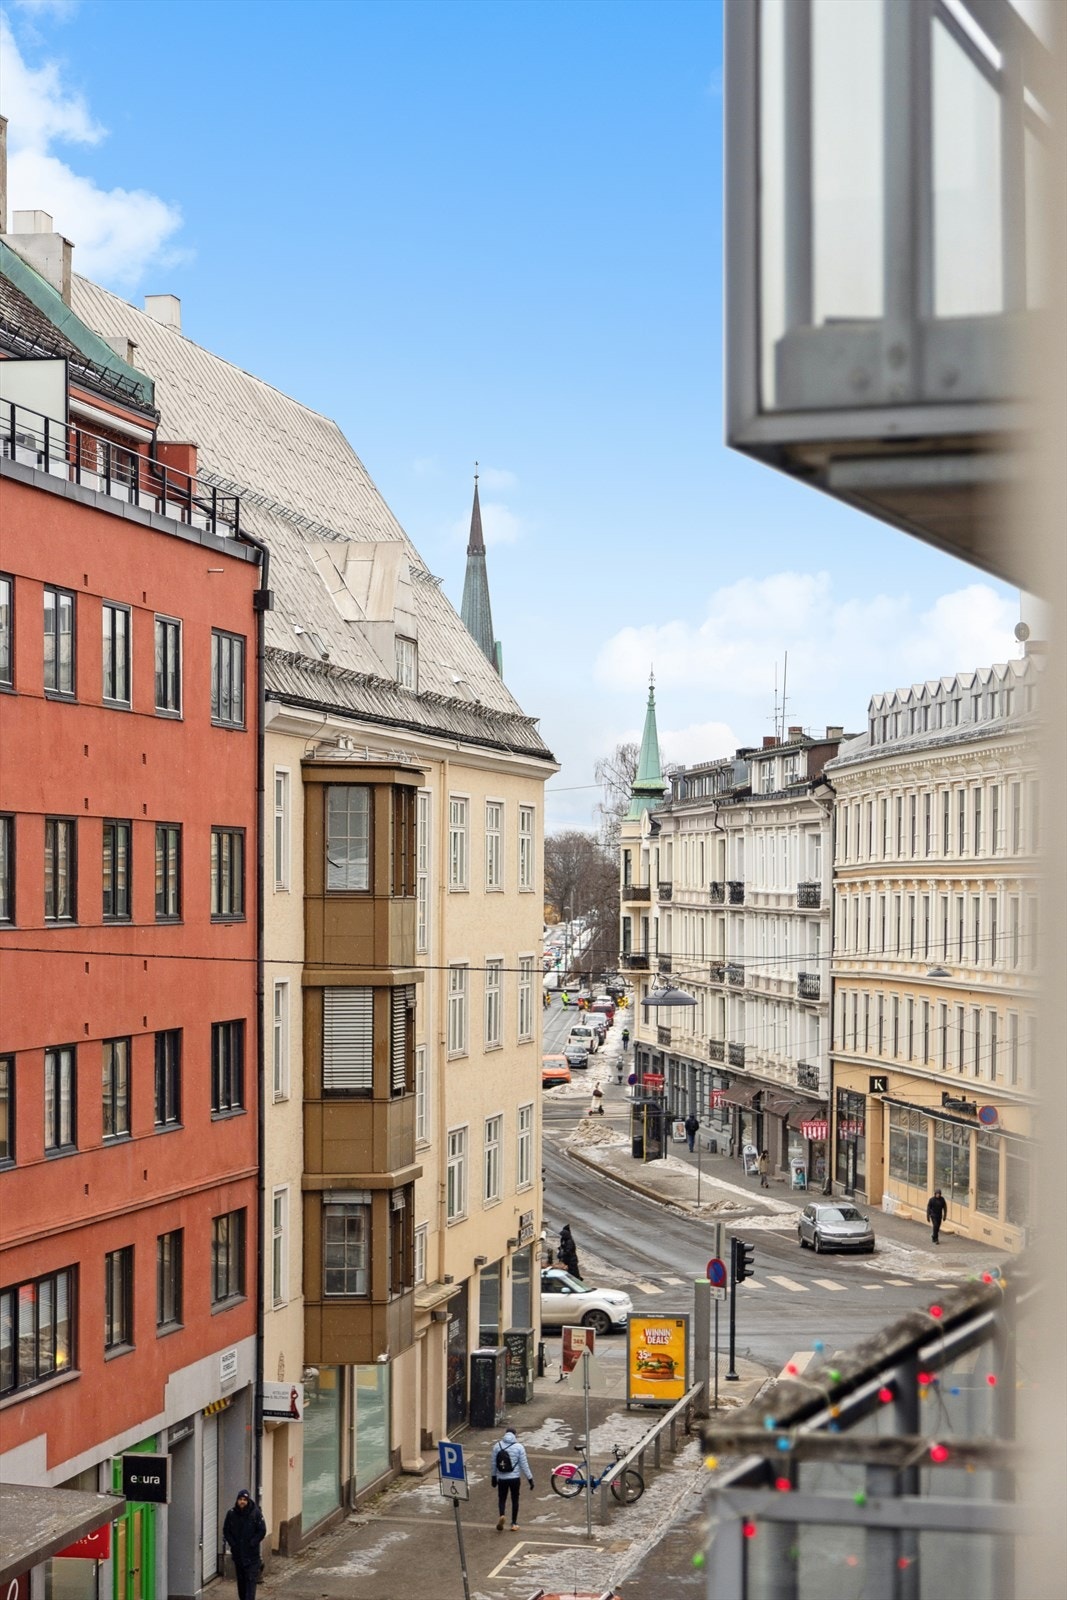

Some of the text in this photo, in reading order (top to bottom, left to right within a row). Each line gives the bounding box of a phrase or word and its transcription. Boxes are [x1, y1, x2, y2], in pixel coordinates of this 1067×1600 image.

[874, 1079, 884, 1091] K
[647, 1336, 669, 1345] DEALS
[444, 1446, 457, 1473] P
